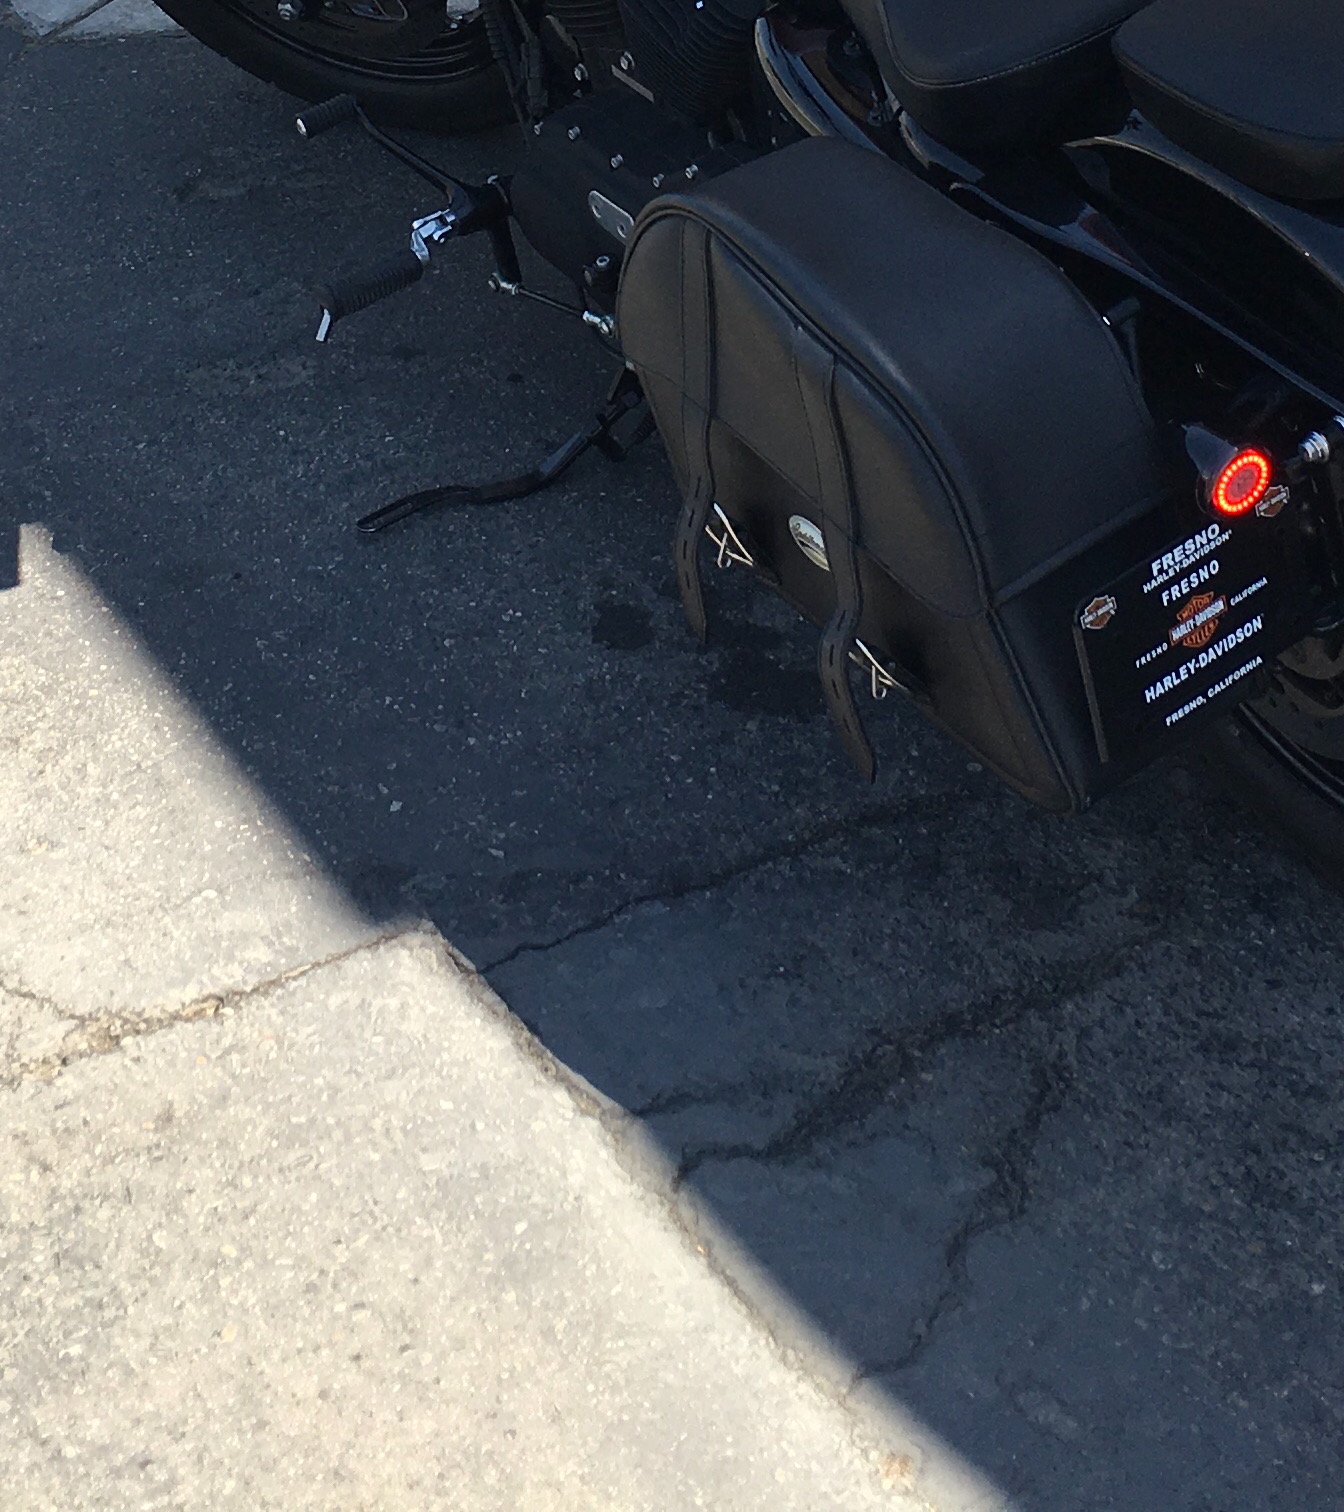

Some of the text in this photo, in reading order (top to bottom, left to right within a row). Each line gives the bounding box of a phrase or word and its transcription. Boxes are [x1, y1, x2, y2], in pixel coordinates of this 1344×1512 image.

[1142, 531, 1231, 593] HARLEY-DAVIDSON
[1151, 523, 1220, 577] FRESNO
[1161, 559, 1219, 607] FRESNO
[1135, 576, 1268, 668] FRESNO HARLEY-DAVIDSON CALIFORNIA
[1144, 615, 1263, 704] HARLEY-DAVIDSON
[1165, 656, 1263, 727] FRESNO, CALIFORNIA
